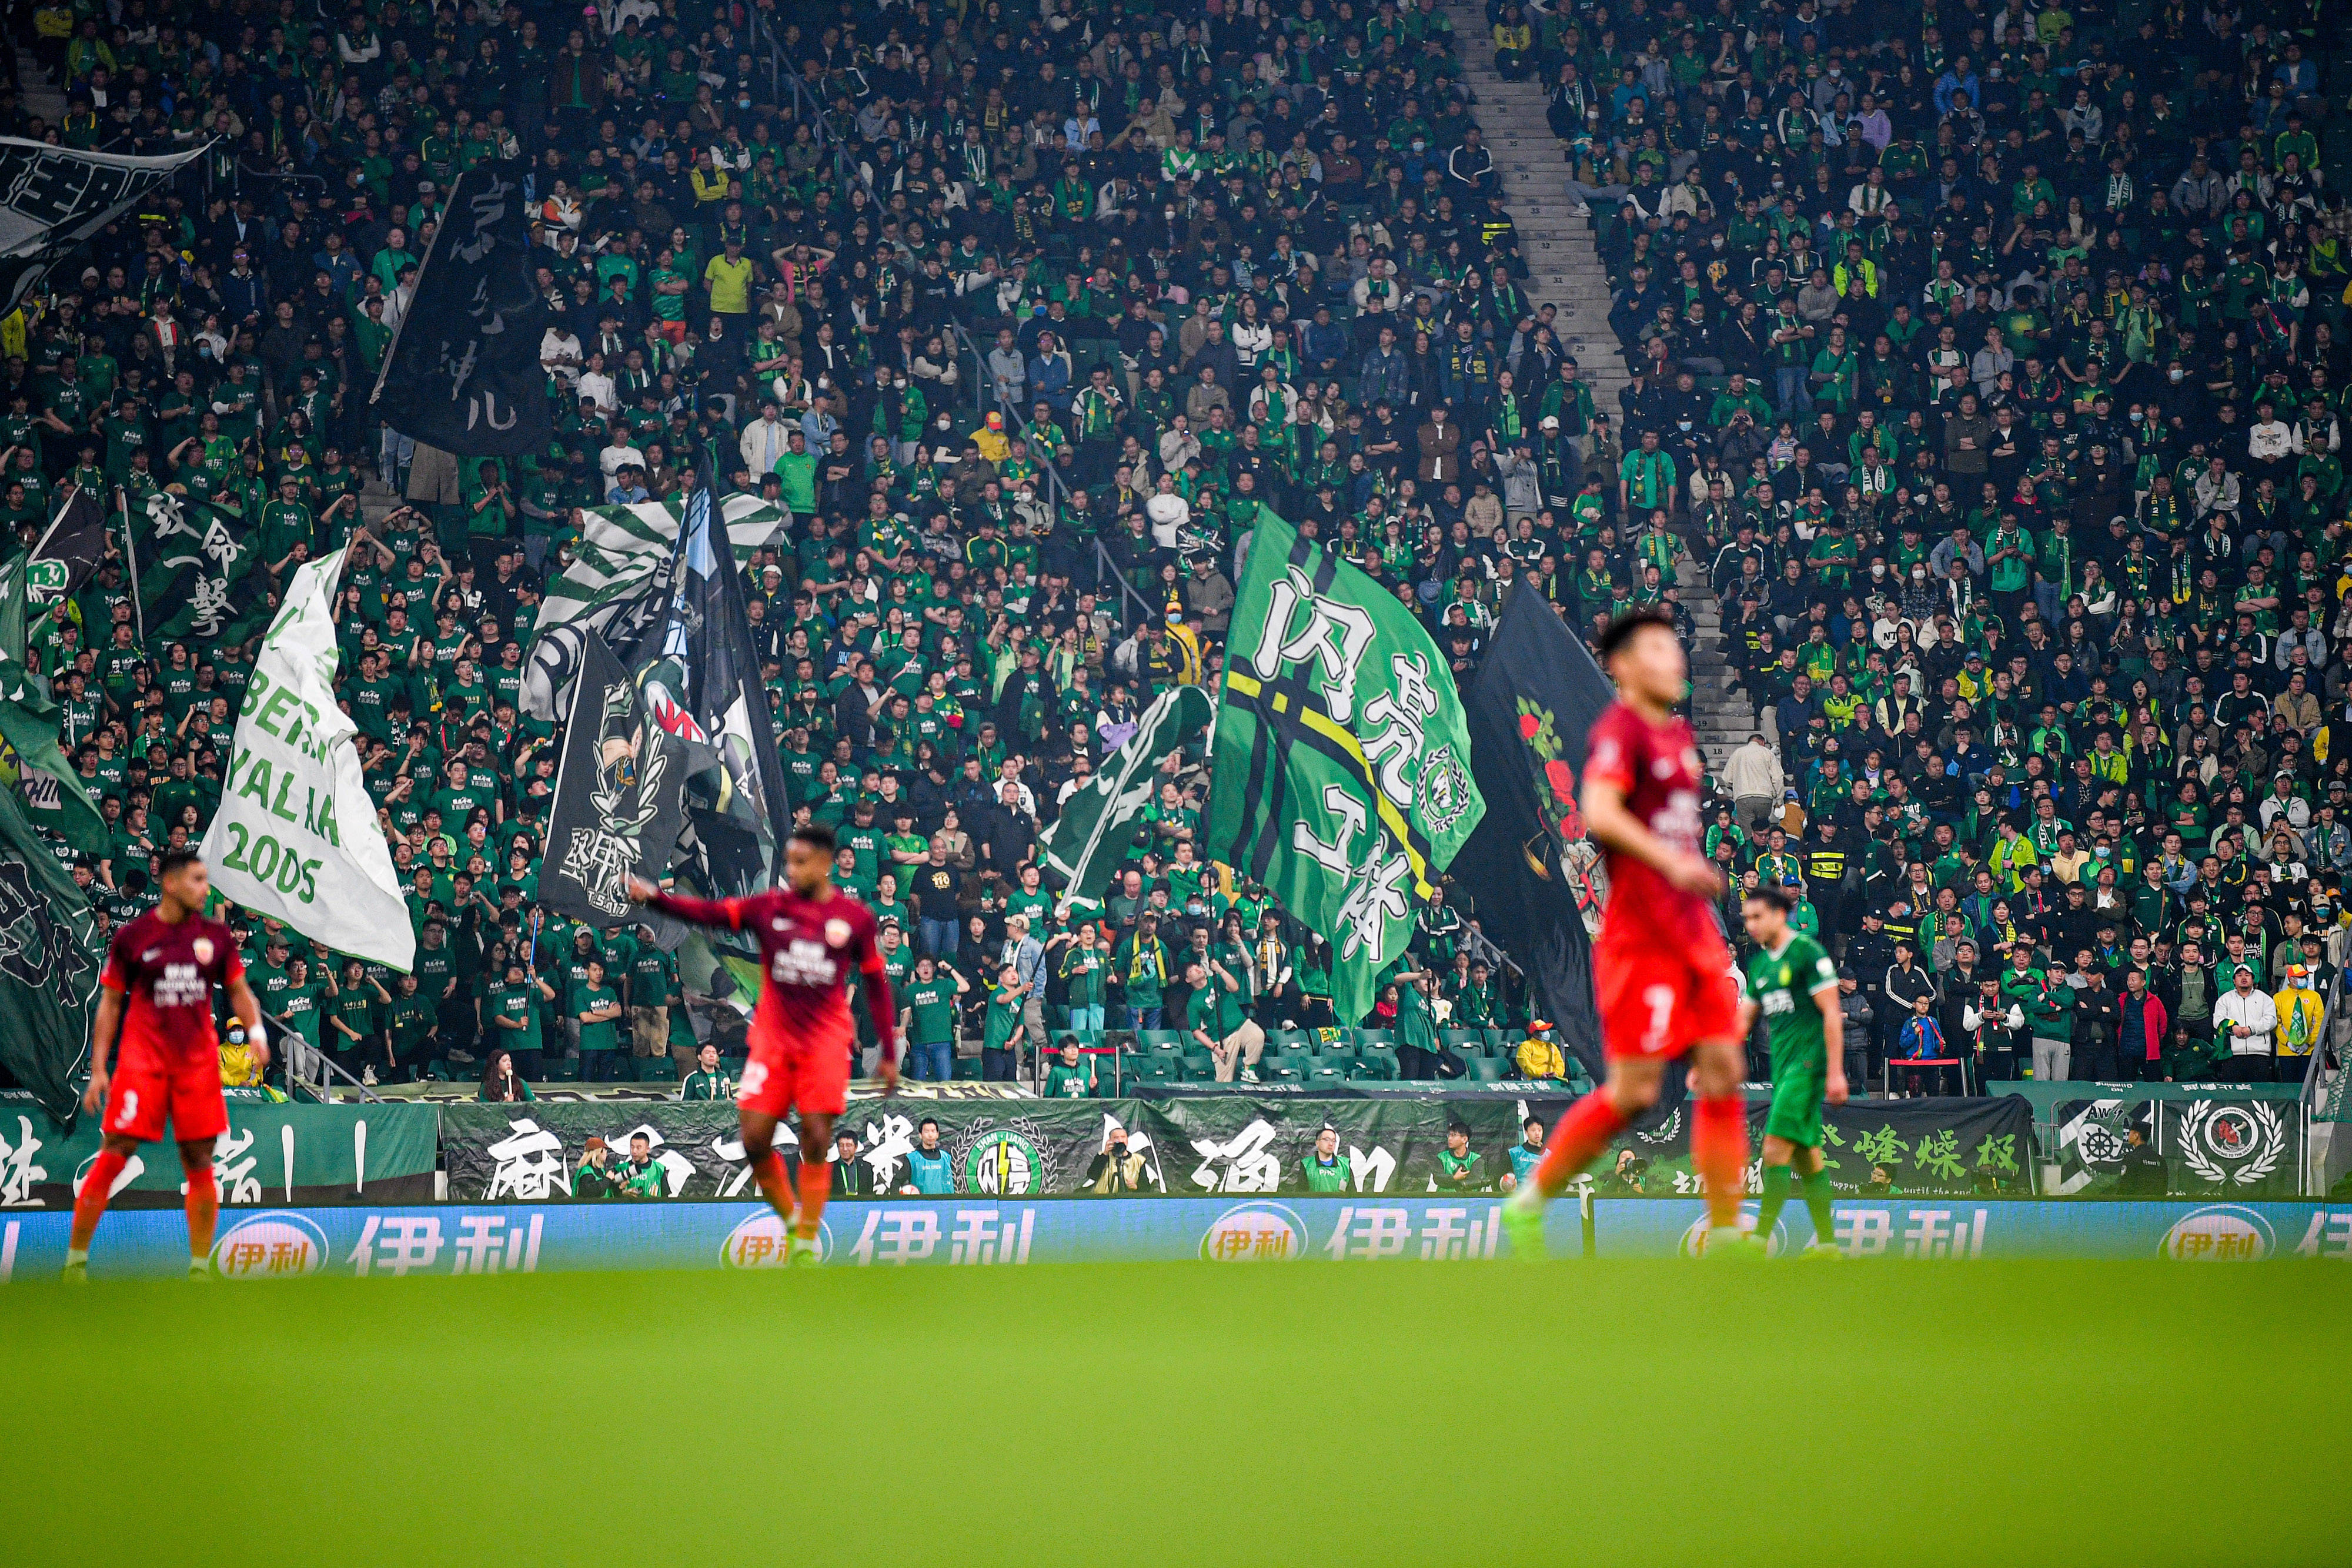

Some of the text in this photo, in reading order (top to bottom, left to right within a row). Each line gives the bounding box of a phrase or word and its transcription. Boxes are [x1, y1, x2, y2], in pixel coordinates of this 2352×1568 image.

[222, 821, 323, 904] 2005
[976, 1132, 1029, 1151] SHAN LIANG
[347, 1213, 544, 1276] 伊利
[850, 1208, 1037, 1265] 伊利
[1215, 1229, 1290, 1261] 伊利
[1324, 1206, 1501, 1261] 伊利
[2177, 1232, 2256, 1259] 伊利
[225, 1242, 309, 1275] 伊利
